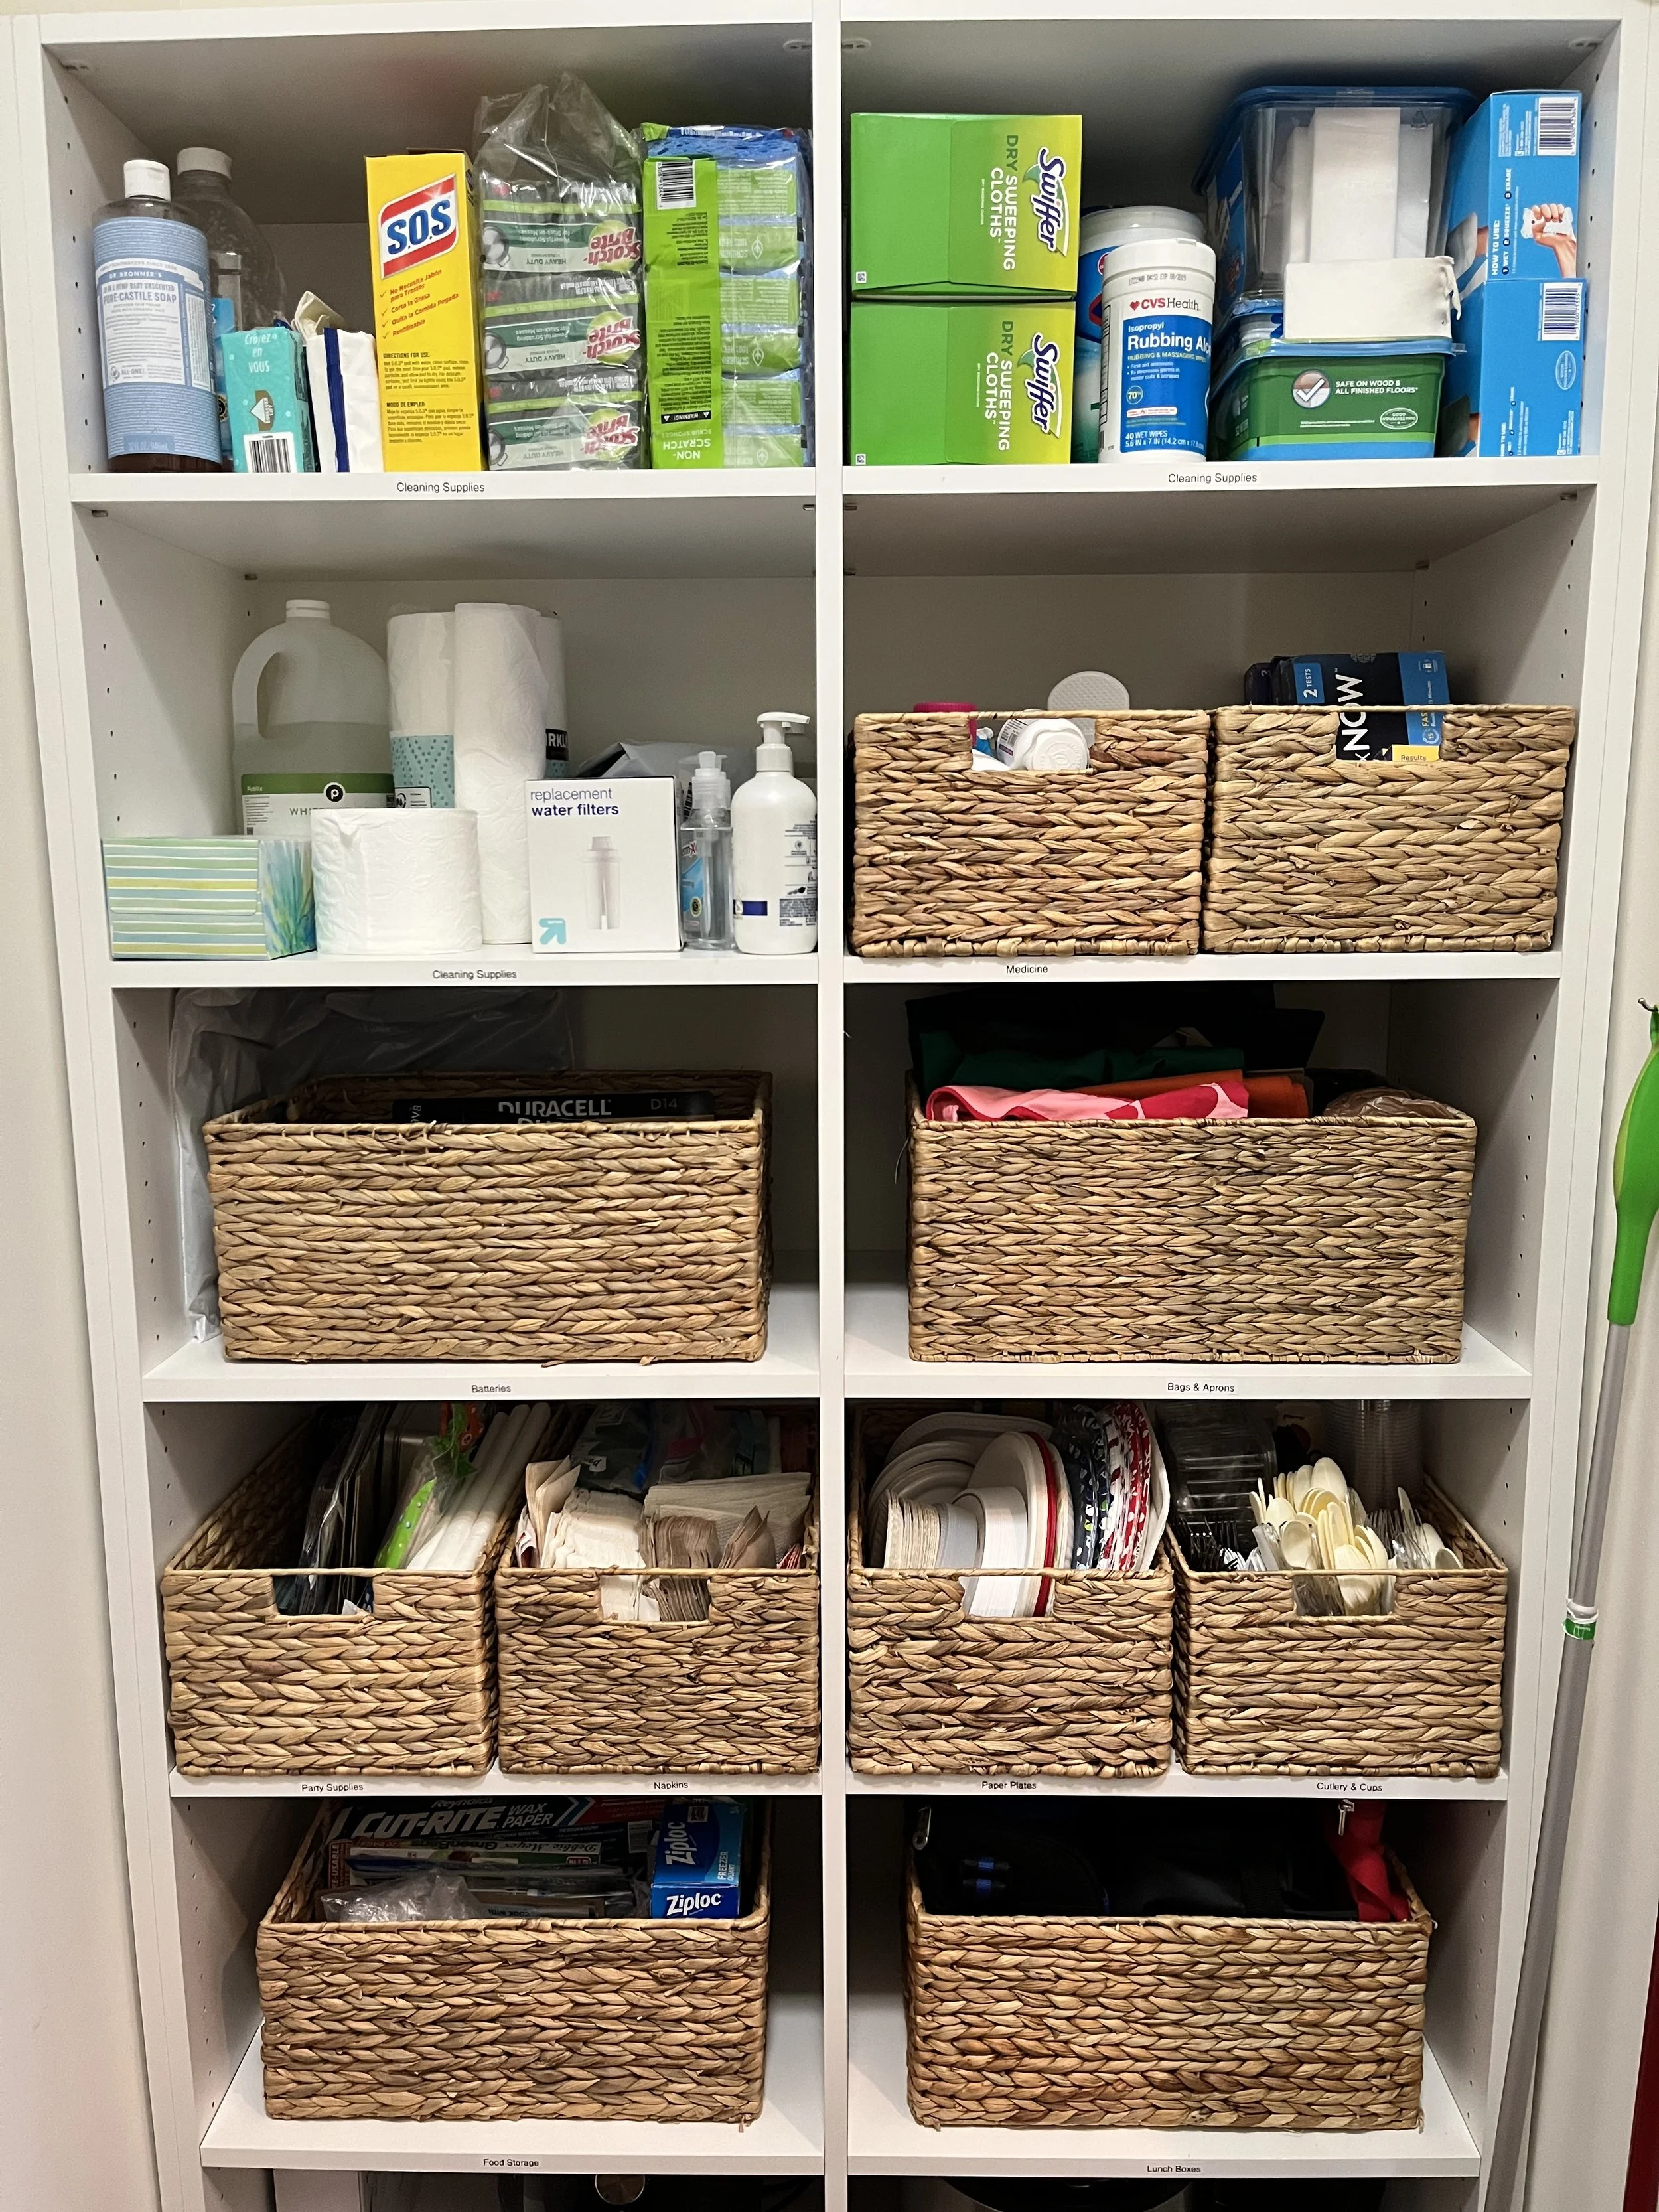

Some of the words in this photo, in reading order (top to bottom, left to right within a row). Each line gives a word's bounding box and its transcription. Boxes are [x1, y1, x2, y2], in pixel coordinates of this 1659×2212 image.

[1007, 135, 1019, 171] DRY
[1031, 147, 1068, 252] Swiffer
[1003, 175, 1018, 270] SWEEPING
[1492, 241, 1499, 252] TO
[399, 277, 423, 291] Necesita
[103, 291, 152, 305] PURE-CASTILE
[155, 293, 177, 303] SOAP
[390, 293, 403, 303] para
[404, 283, 425, 296] Trastes
[391, 303, 406, 313] Corta
[414, 293, 430, 303] Grasa
[392, 315, 407, 325] Quita
[415, 303, 436, 315] Comida
[437, 293, 459, 307] Pegada
[1141, 297, 1166, 310] CVS
[1167, 297, 1200, 311] Health
[1128, 321, 1164, 332] Isopropyl
[1001, 321, 1013, 356] DRY
[1127, 332, 1193, 352] Rubbing
[252, 347, 263, 357] en
[1127, 352, 1155, 361] RUBBING
[1161, 352, 1195, 360] MASSAGING
[248, 360, 270, 374] VOUS
[1025, 332, 1060, 433] Swiffer
[998, 360, 1013, 451] SWEEPING
[674, 413, 699, 421] WARNING!
[663, 438, 711, 450] SCRATCH
[673, 450, 701, 460] NON-
[1168, 473, 1212, 484] Cleaning
[1214, 473, 1258, 484] Supplies
[396, 482, 440, 493] Cleaning
[443, 482, 485, 493] Supplies
[530, 788, 613, 804] replacement
[531, 804, 573, 816] water
[577, 804, 619, 816] filters
[432, 970, 474, 980] Cleaning
[476, 969, 517, 980] Supplies
[1006, 964, 1048, 974] Medicine
[650, 1098, 678, 1111] D14
[471, 1384, 512, 1393] Batteries
[1167, 1382, 1190, 1392] Bags
[1193, 1382, 1200, 1392] &
[1202, 1383, 1235, 1392] Aprons
[326, 1783, 364, 1792] Supplies
[654, 1781, 689, 1789] Napkins
[981, 1781, 1007, 1789] Paper
[1010, 1781, 1037, 1789] Plates
[1317, 1782, 1348, 1791] Cutlery
[1359, 1783, 1383, 1791] Cups
[431, 1797, 493, 1808] Reynolds
[508, 1803, 547, 1815] WAX
[351, 1806, 506, 1840] CUT-RITE
[502, 1812, 554, 1828] PAPER
[552, 1842, 597, 1854] Debbie
[664, 1822, 697, 1866] Ziploc
[717, 1851, 729, 1880] FREEZER
[727, 1863, 736, 1881] QUART
[666, 1893, 721, 1916] Ziploc
[506, 2158, 539, 2167] Storage
